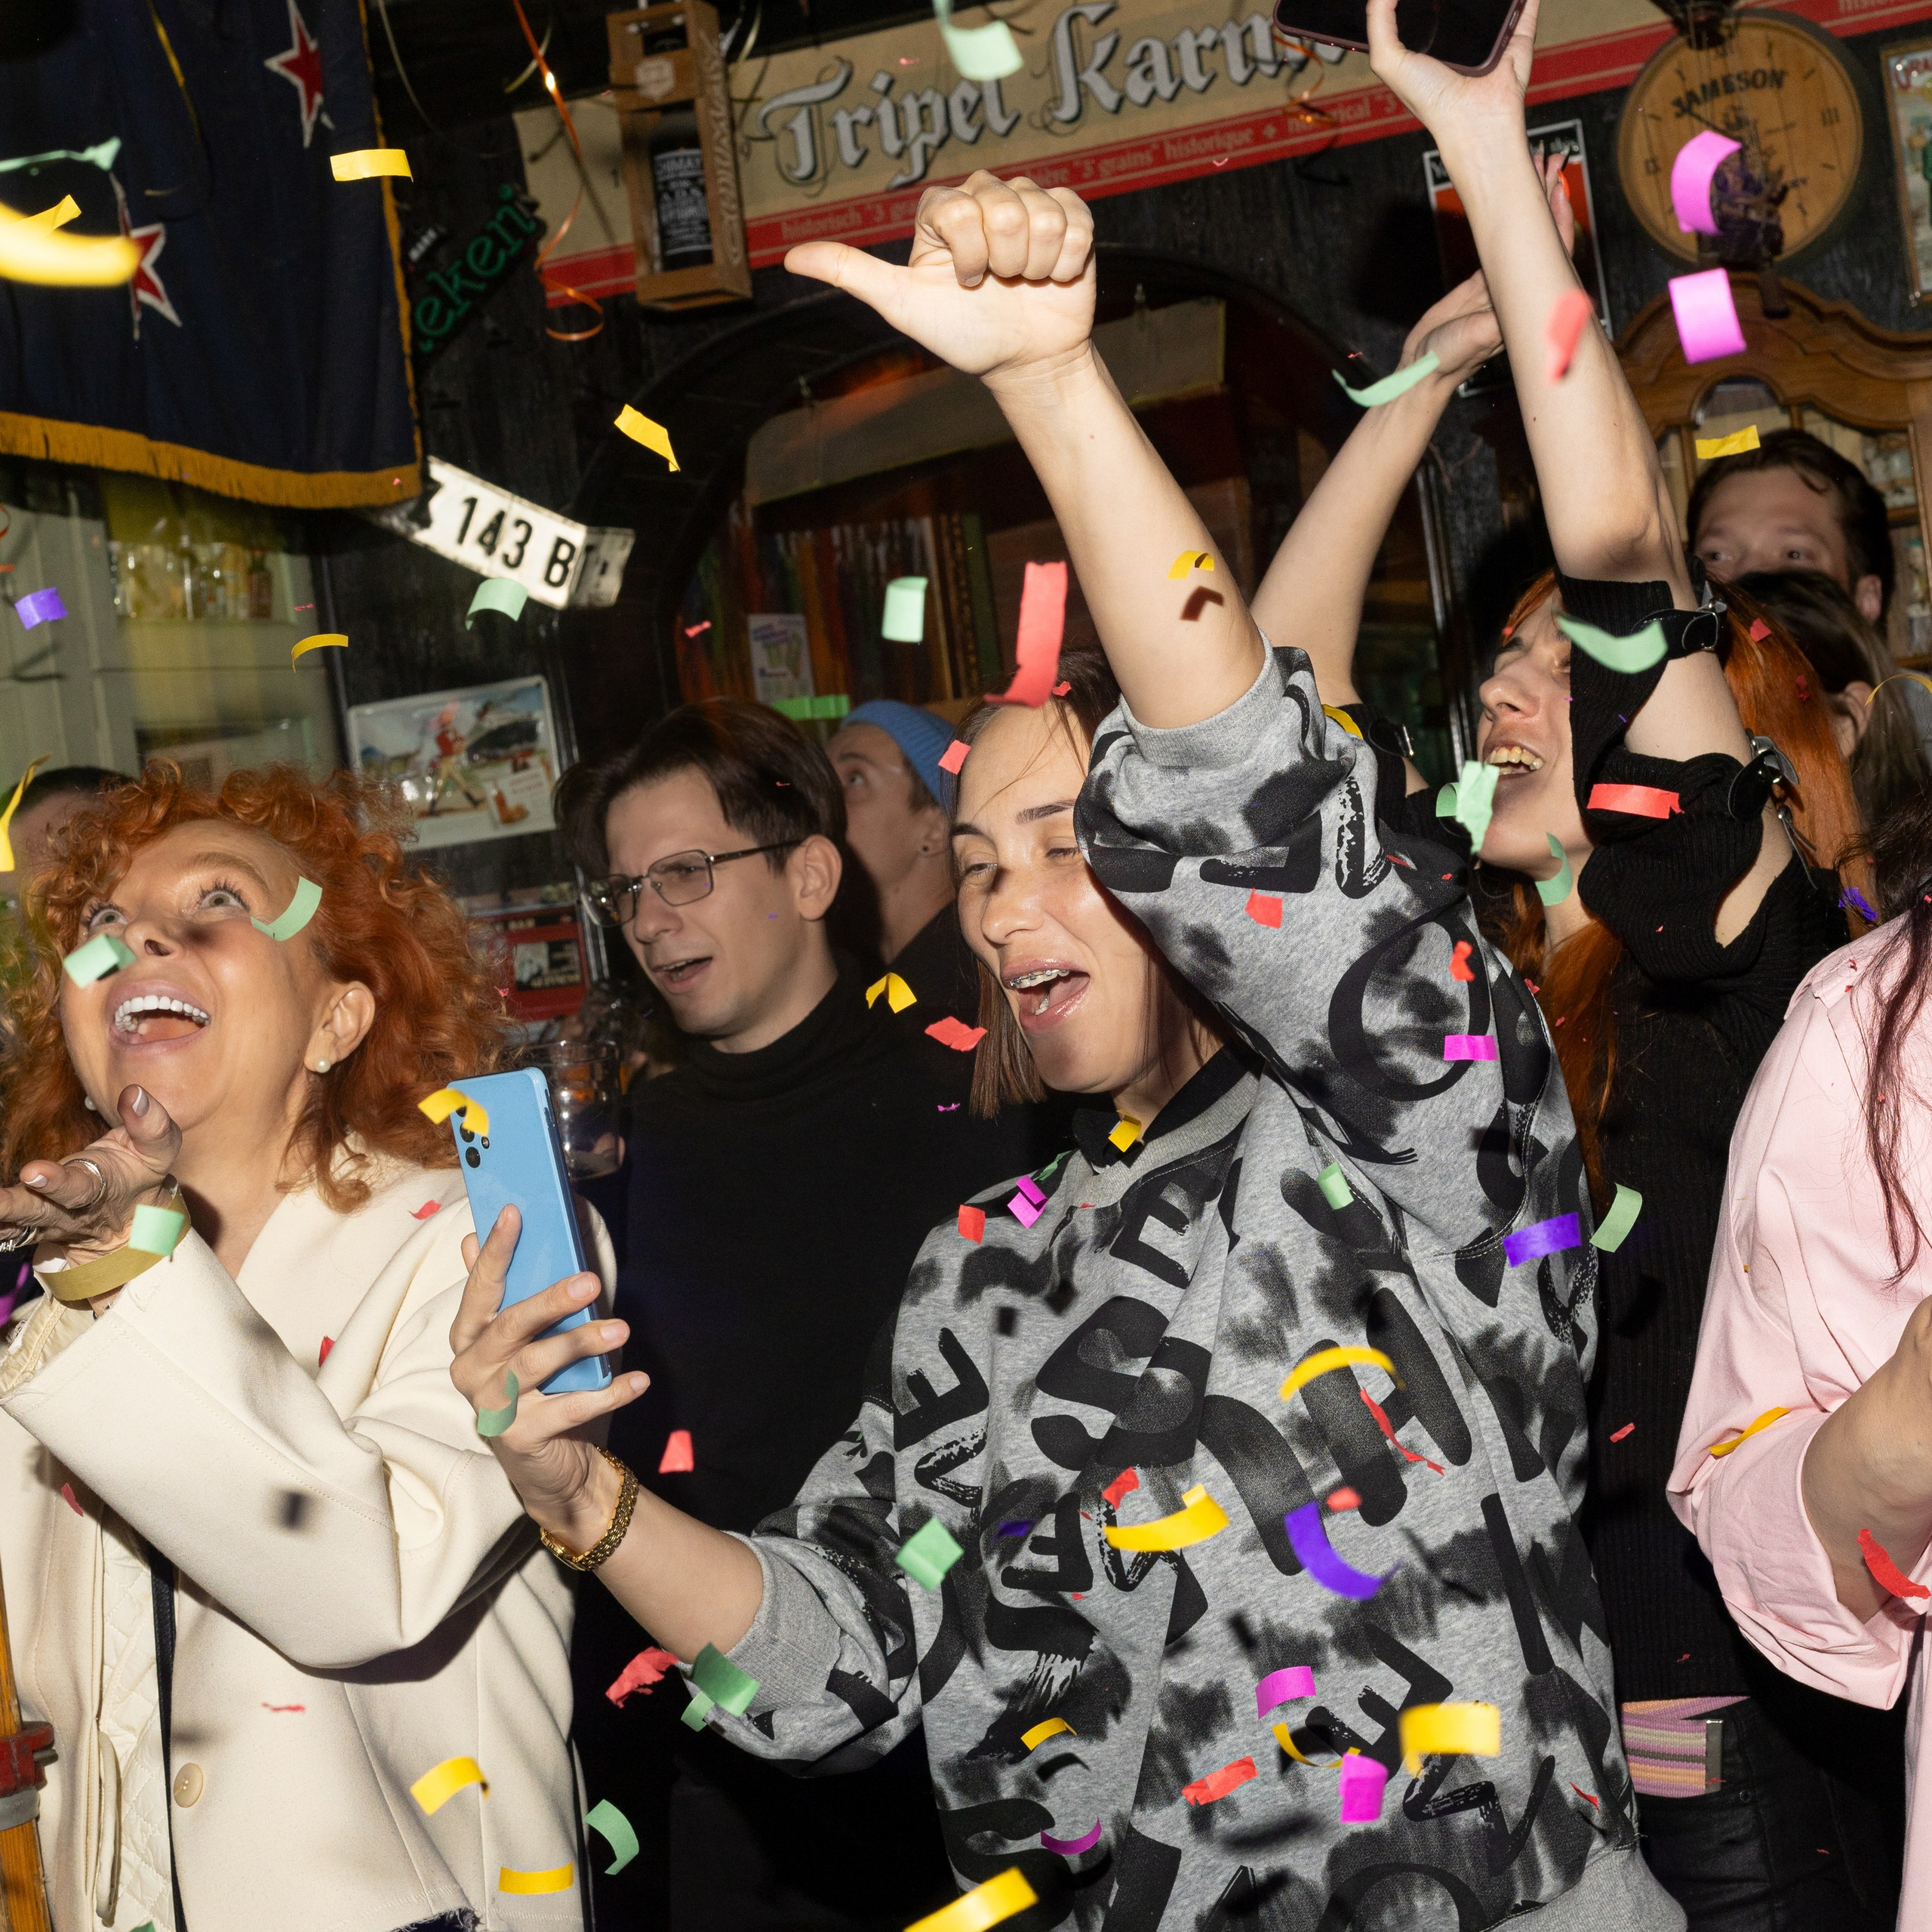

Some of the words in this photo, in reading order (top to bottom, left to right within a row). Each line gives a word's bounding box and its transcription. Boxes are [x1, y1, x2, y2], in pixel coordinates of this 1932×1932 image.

[756, 54, 1021, 190] Tripel
[1672, 69, 1786, 118] JAMESON
[414, 204, 537, 352] eken
[457, 495, 534, 571] 143
